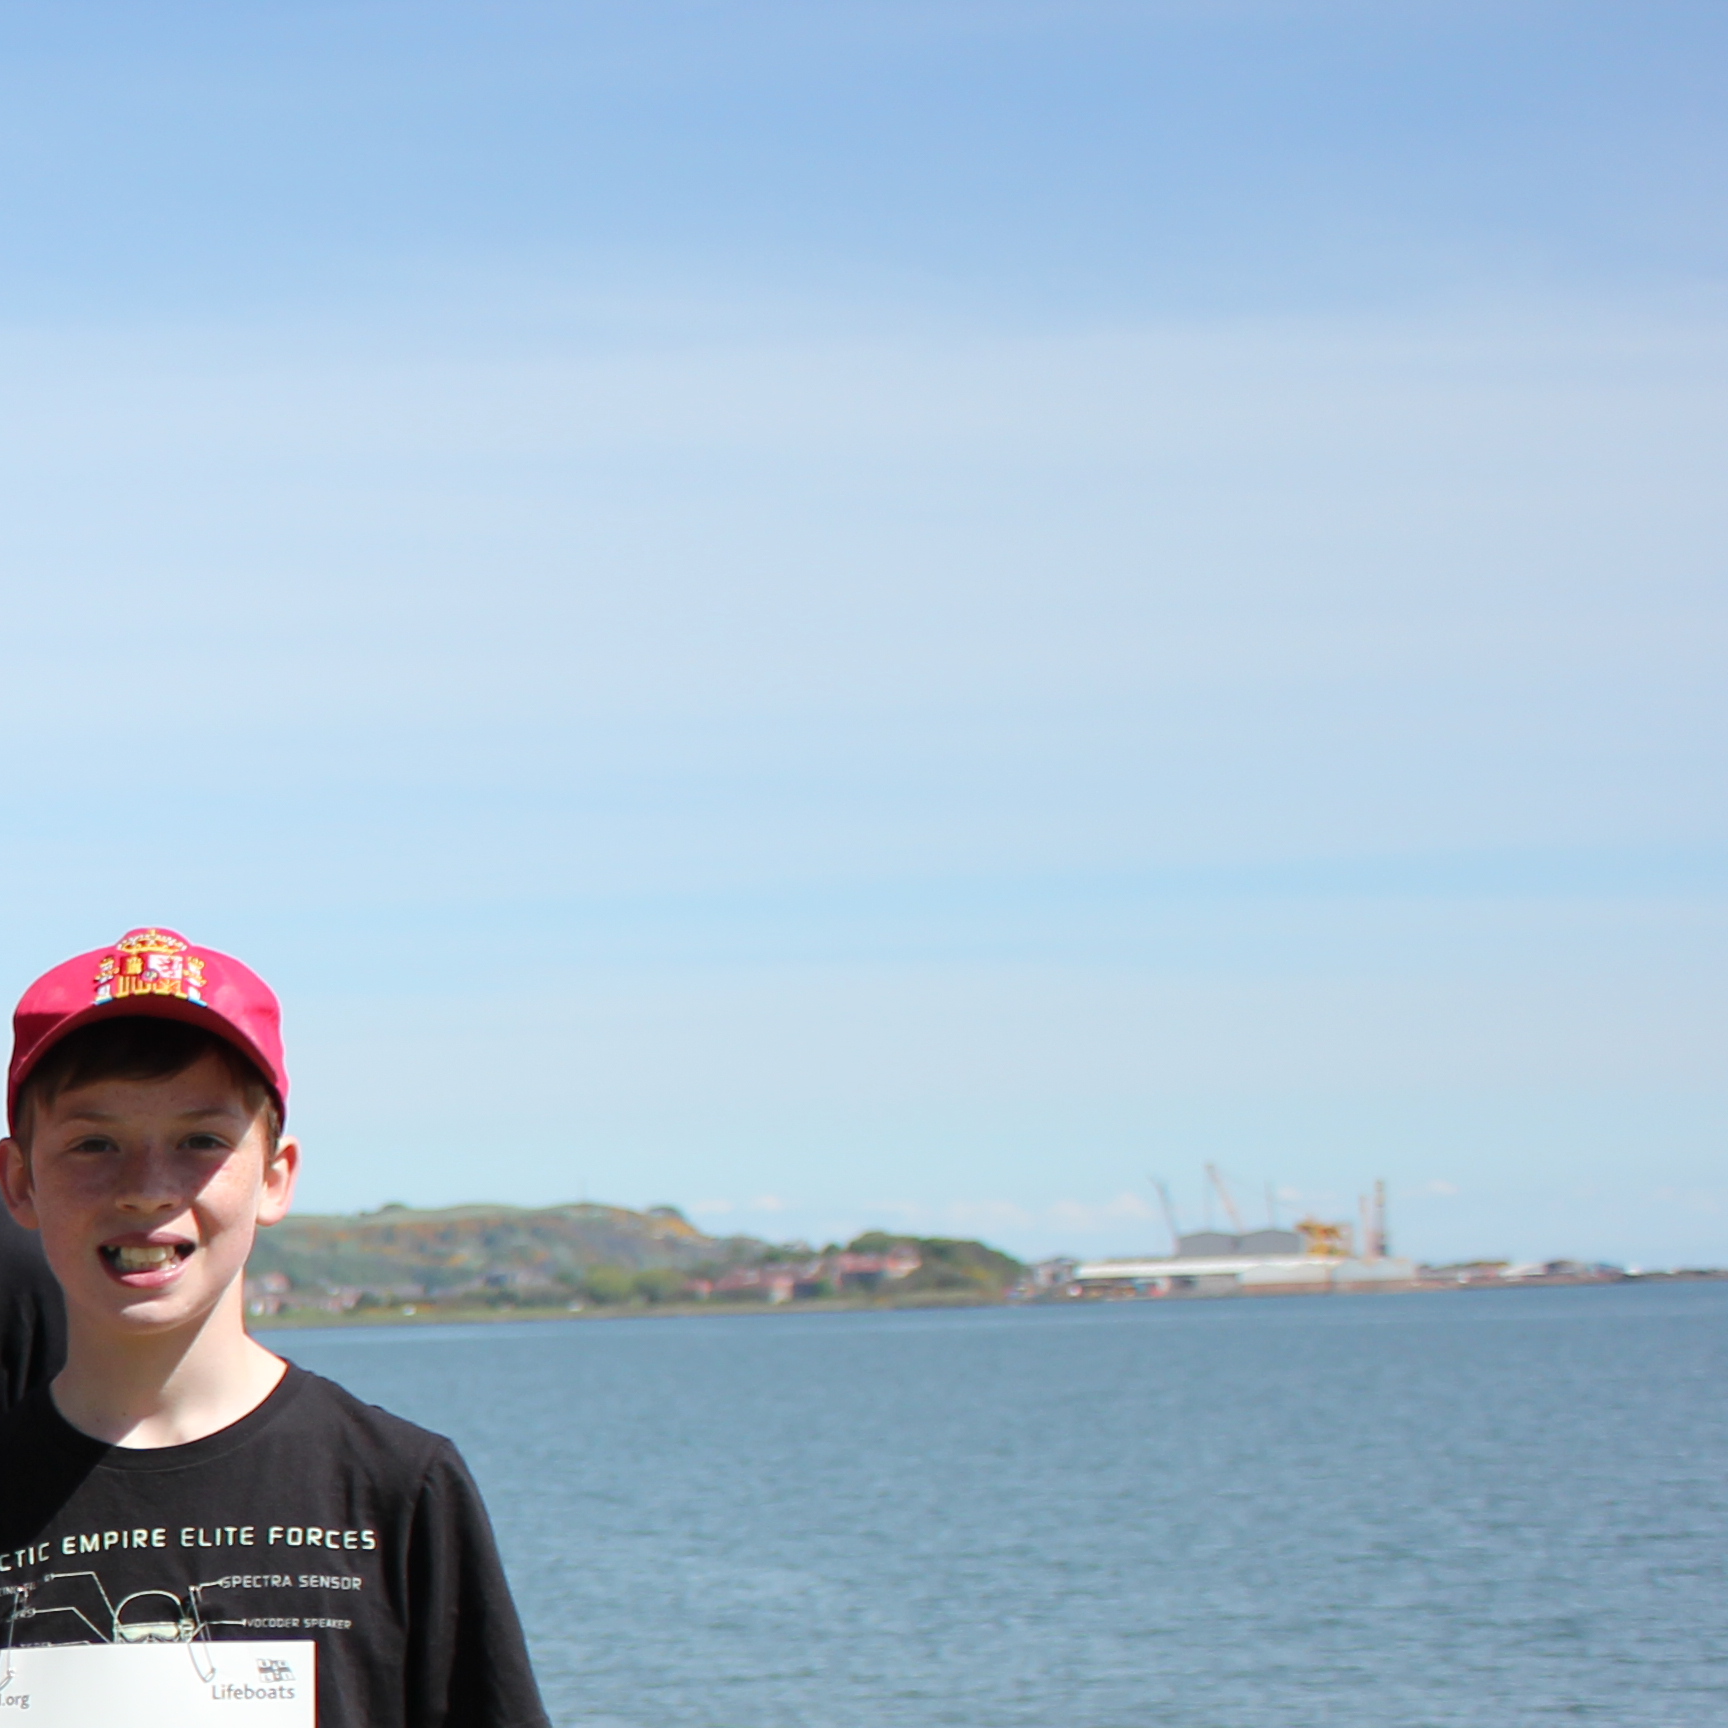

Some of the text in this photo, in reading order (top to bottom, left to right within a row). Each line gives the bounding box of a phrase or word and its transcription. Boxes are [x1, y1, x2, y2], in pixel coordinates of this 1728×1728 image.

[62, 1527, 168, 1555] EMPIRE
[180, 1526, 255, 1548] ELITE
[268, 1526, 377, 1550] FORCES
[221, 1574, 363, 1591] SPECTRA SENSOR
[303, 1617, 352, 1630] SPEAKER
[211, 1684, 296, 1701] Lifeboats
